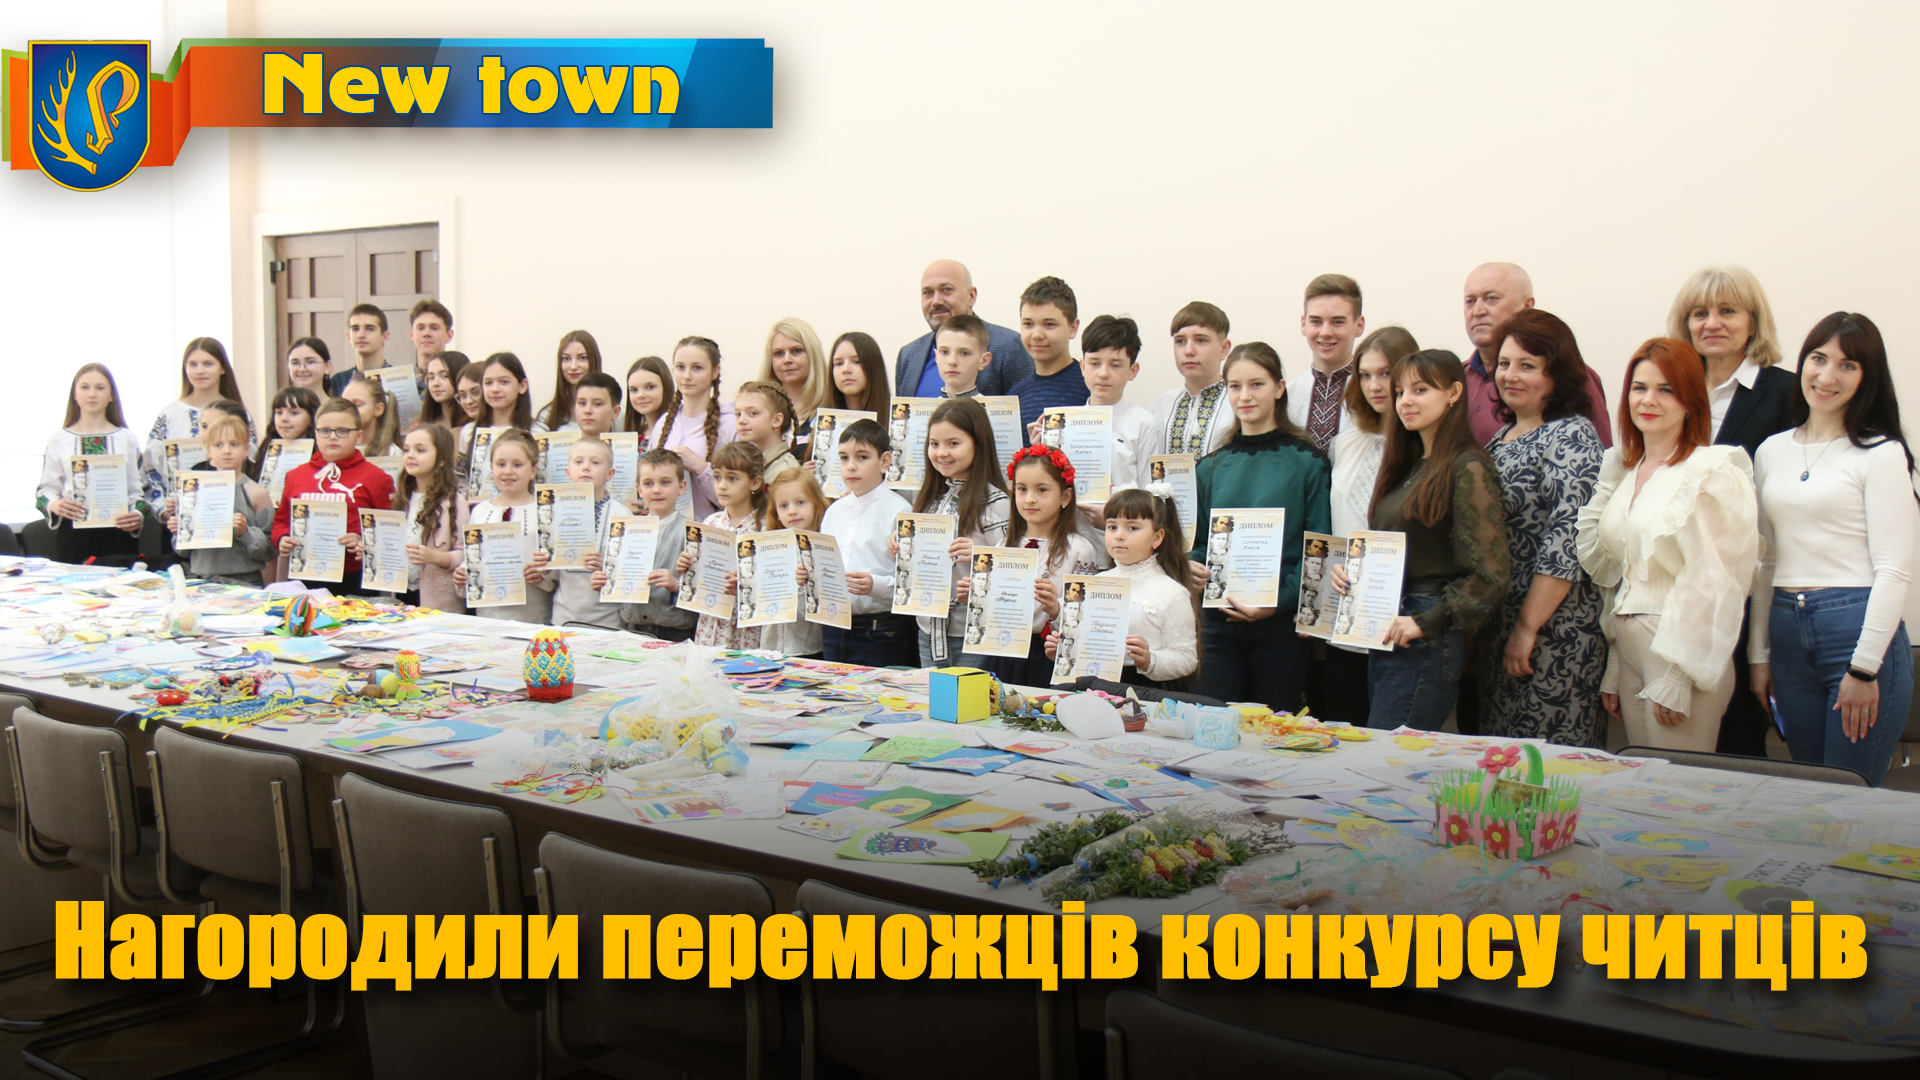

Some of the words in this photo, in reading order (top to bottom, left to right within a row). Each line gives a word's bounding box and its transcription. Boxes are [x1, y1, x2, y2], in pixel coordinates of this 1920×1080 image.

[919, 527, 946, 535] ДИПЛОМ
[487, 533, 515, 541] ДИПЛОМ
[705, 536, 730, 548] ДИПЛОМ
[759, 543, 788, 552] ДИПЛОМ
[1369, 546, 1397, 556] ДИПЛОМ
[1333, 550, 1347, 558] ДИП
[997, 561, 1029, 570] ДИПЛОМ
[1090, 591, 1122, 600] ДИПЛОМ
